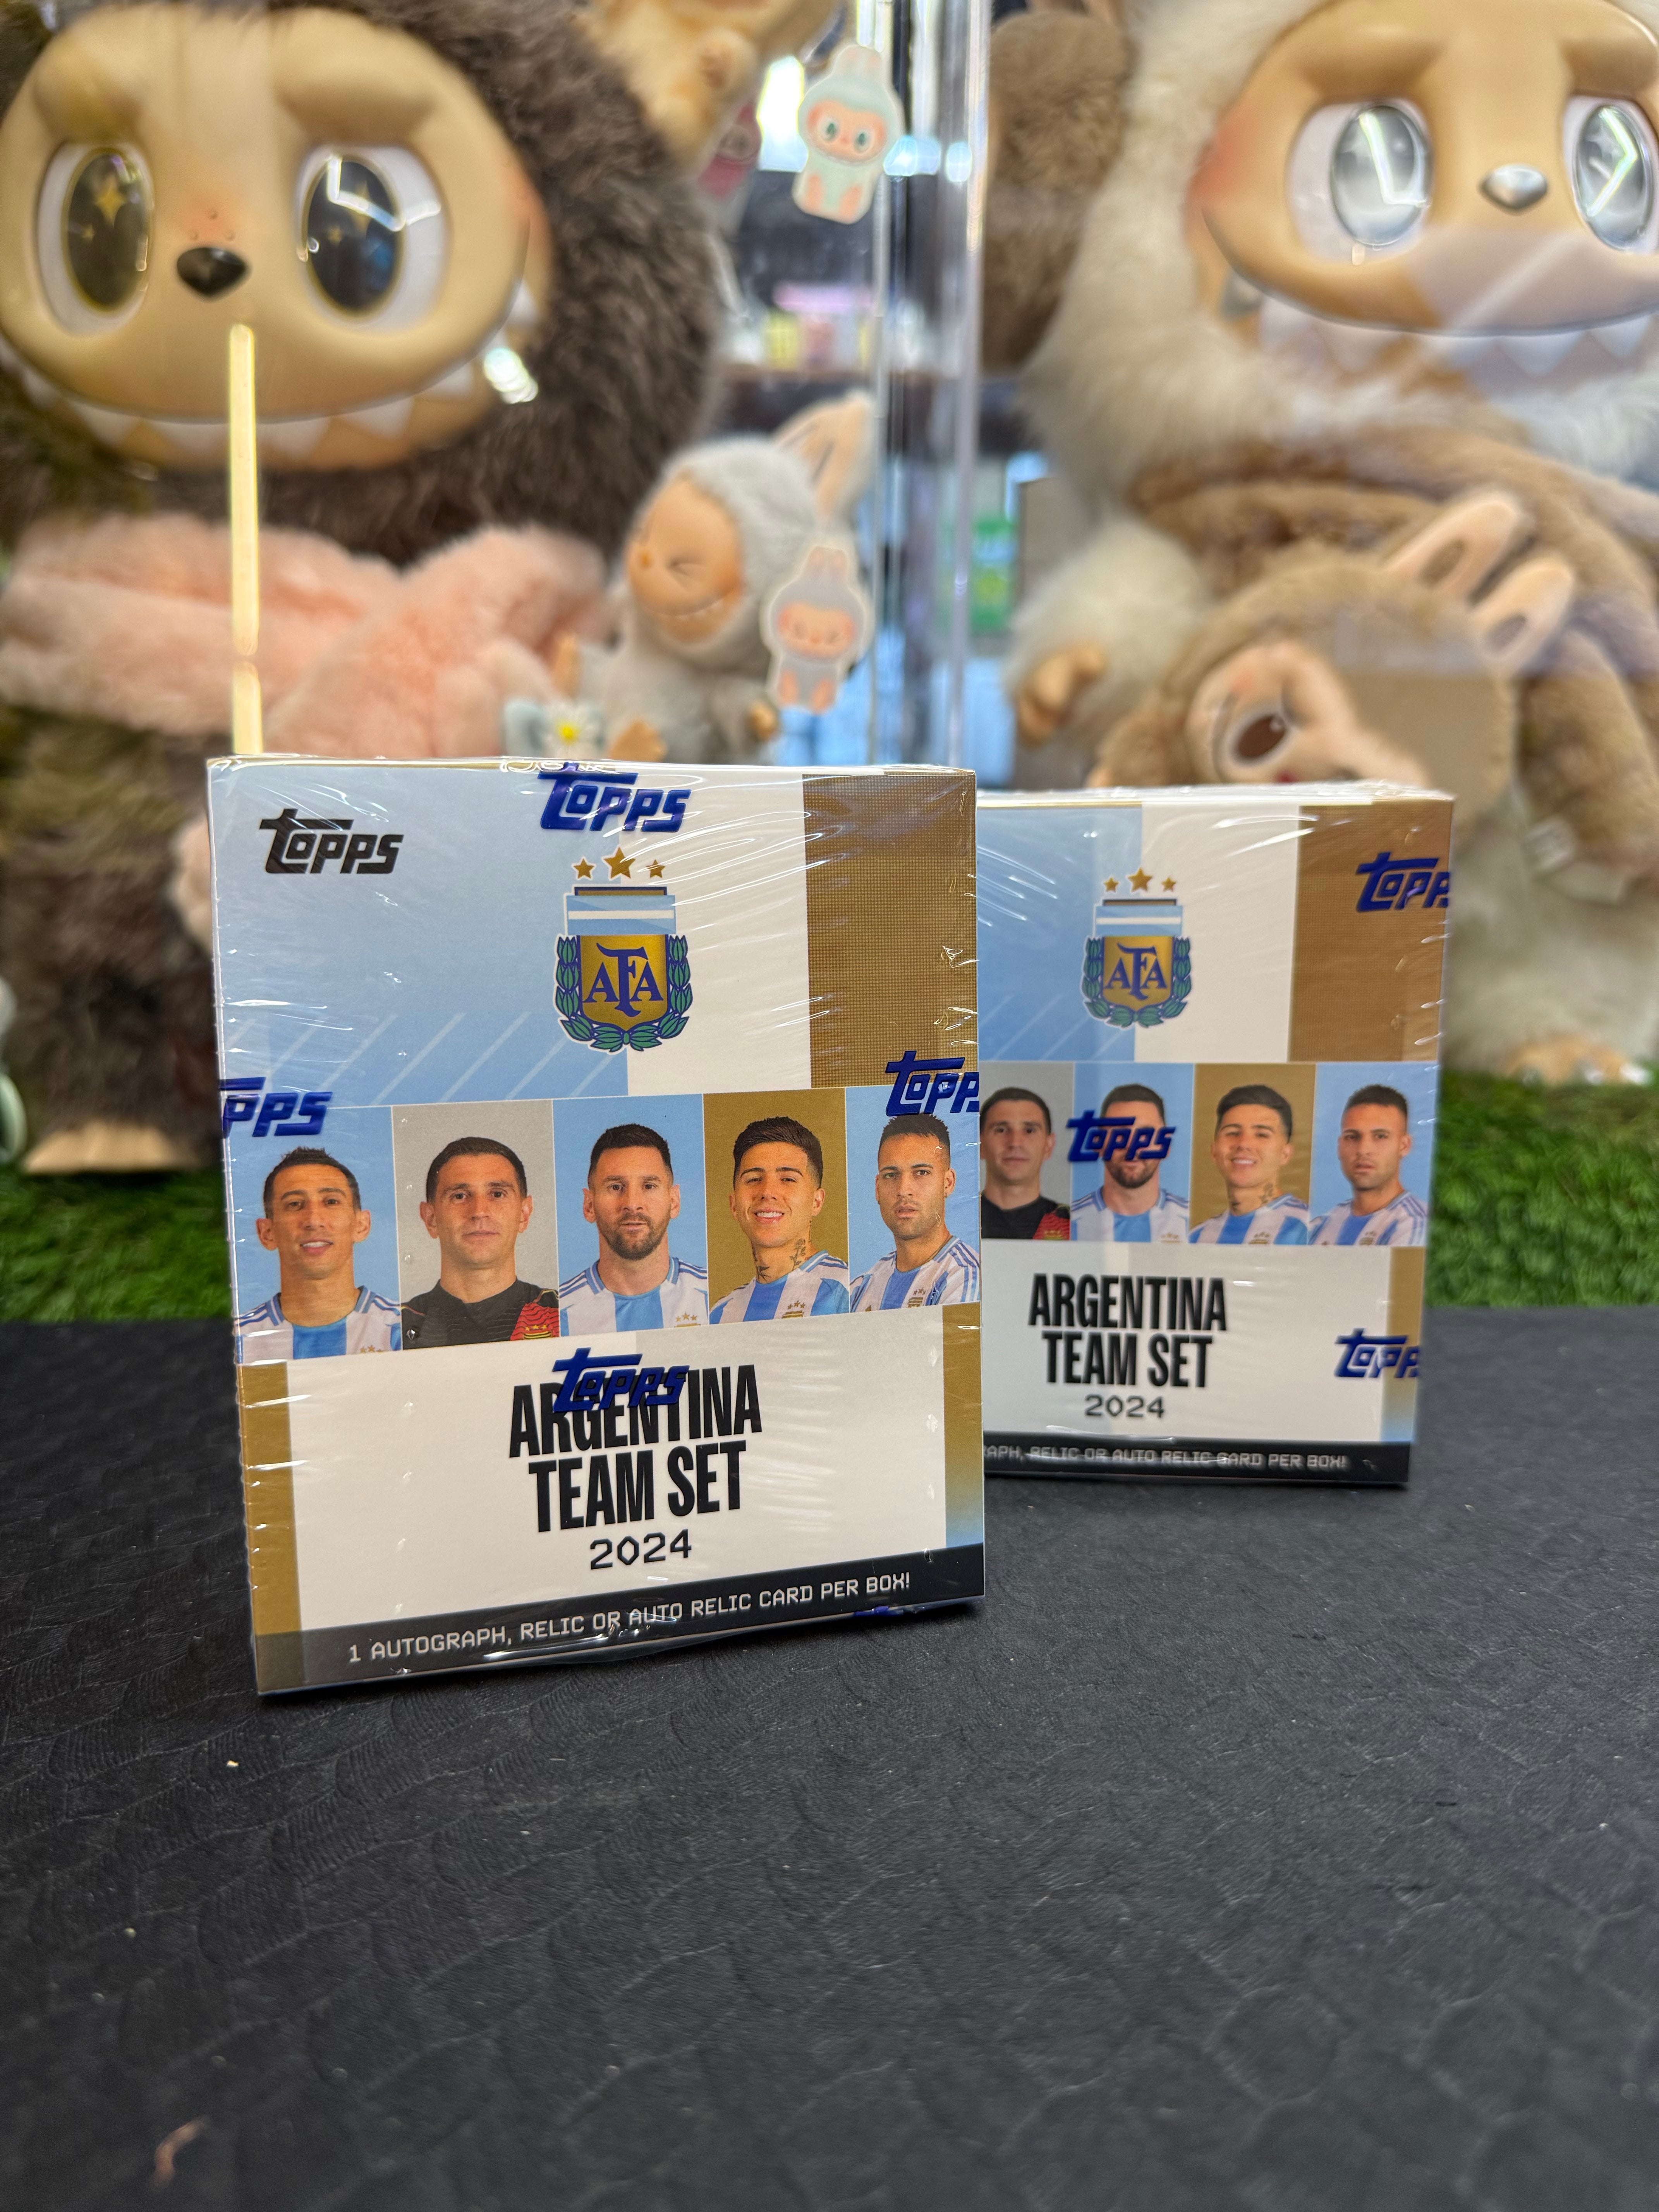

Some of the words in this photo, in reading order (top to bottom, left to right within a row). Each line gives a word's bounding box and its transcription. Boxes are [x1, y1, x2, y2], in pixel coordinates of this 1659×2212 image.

[582, 943, 664, 1017] AFA
[1104, 942, 1167, 1001] AFA
[1028, 1273, 1226, 1331] ARGENTINA
[1042, 1330, 1138, 1385] TEAM
[1147, 1333, 1213, 1388] SET
[1085, 1394, 1165, 1418] 2024
[528, 1449, 654, 1532] TEAM
[667, 1440, 746, 1516] SET
[1030, 1446, 1079, 1459] RELIC
[1112, 1449, 1155, 1462] AUTO
[1268, 1454, 1303, 1467] PER
[1307, 1455, 1346, 1469] BOX!
[590, 1529, 692, 1570] 2024
[349, 1645, 361, 1663] 1
[371, 1626, 512, 1659] AUTOGRAPH,
[520, 1615, 584, 1640] RELIC
[592, 1610, 620, 1630] OR
[629, 1602, 683, 1626] AUTO
[691, 1593, 752, 1617] RELIC
[759, 1585, 813, 1607] CARD
[821, 1578, 859, 1600] PER
[866, 1572, 910, 1592] BOX!
